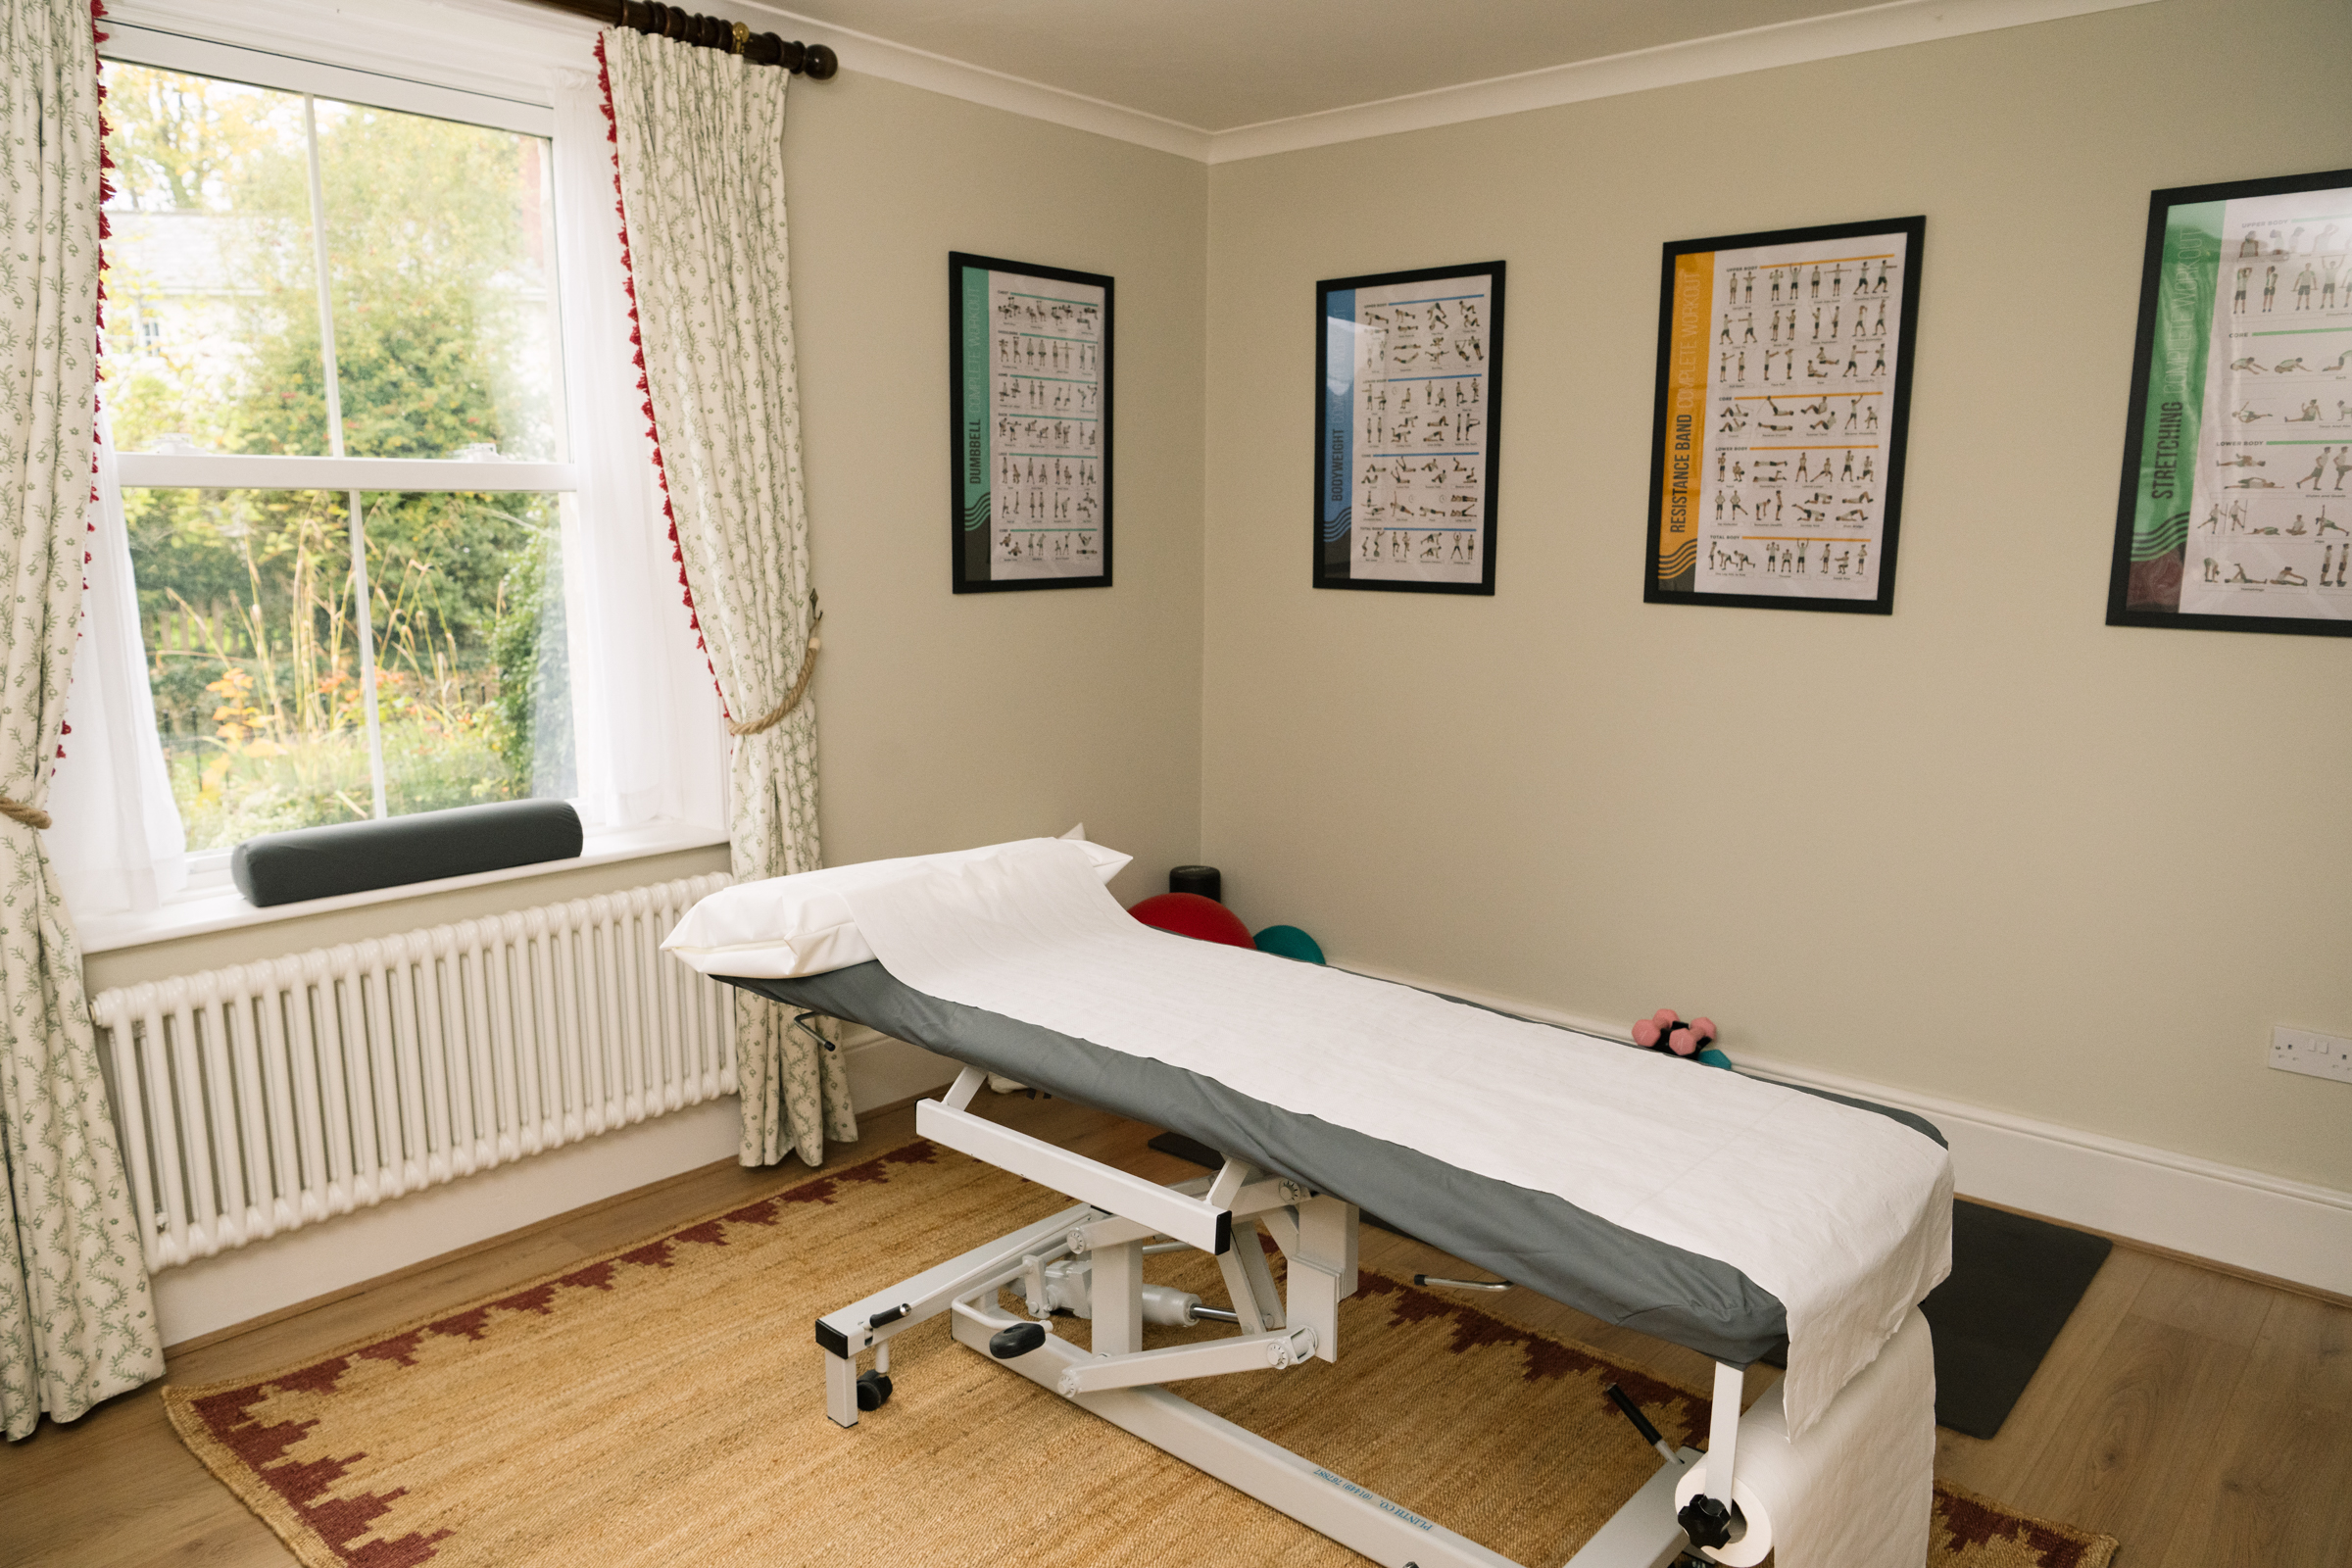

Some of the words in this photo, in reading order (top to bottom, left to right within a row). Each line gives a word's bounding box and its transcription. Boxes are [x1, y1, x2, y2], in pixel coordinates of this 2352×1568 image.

[2171, 228, 2202, 309] WORKOUT
[966, 286, 981, 347] WORKOUT
[1682, 271, 1700, 337] WORKOUT
[968, 352, 981, 414] COMPLETE
[1677, 340, 1697, 409] COMPLETE
[2163, 312, 2194, 394] COMPLETE
[969, 418, 981, 484] DUMBBELL
[1331, 428, 1344, 502] BODYWEIGHT
[1676, 415, 1691, 451] BAND
[2151, 401, 2182, 499] STRETCHING
[1670, 454, 1690, 533] RESISTANCE
[1342, 1483, 1373, 1500] (01449)
[1379, 1499, 1396, 1512] CO.
[1396, 1508, 1433, 1531] PLINTH
